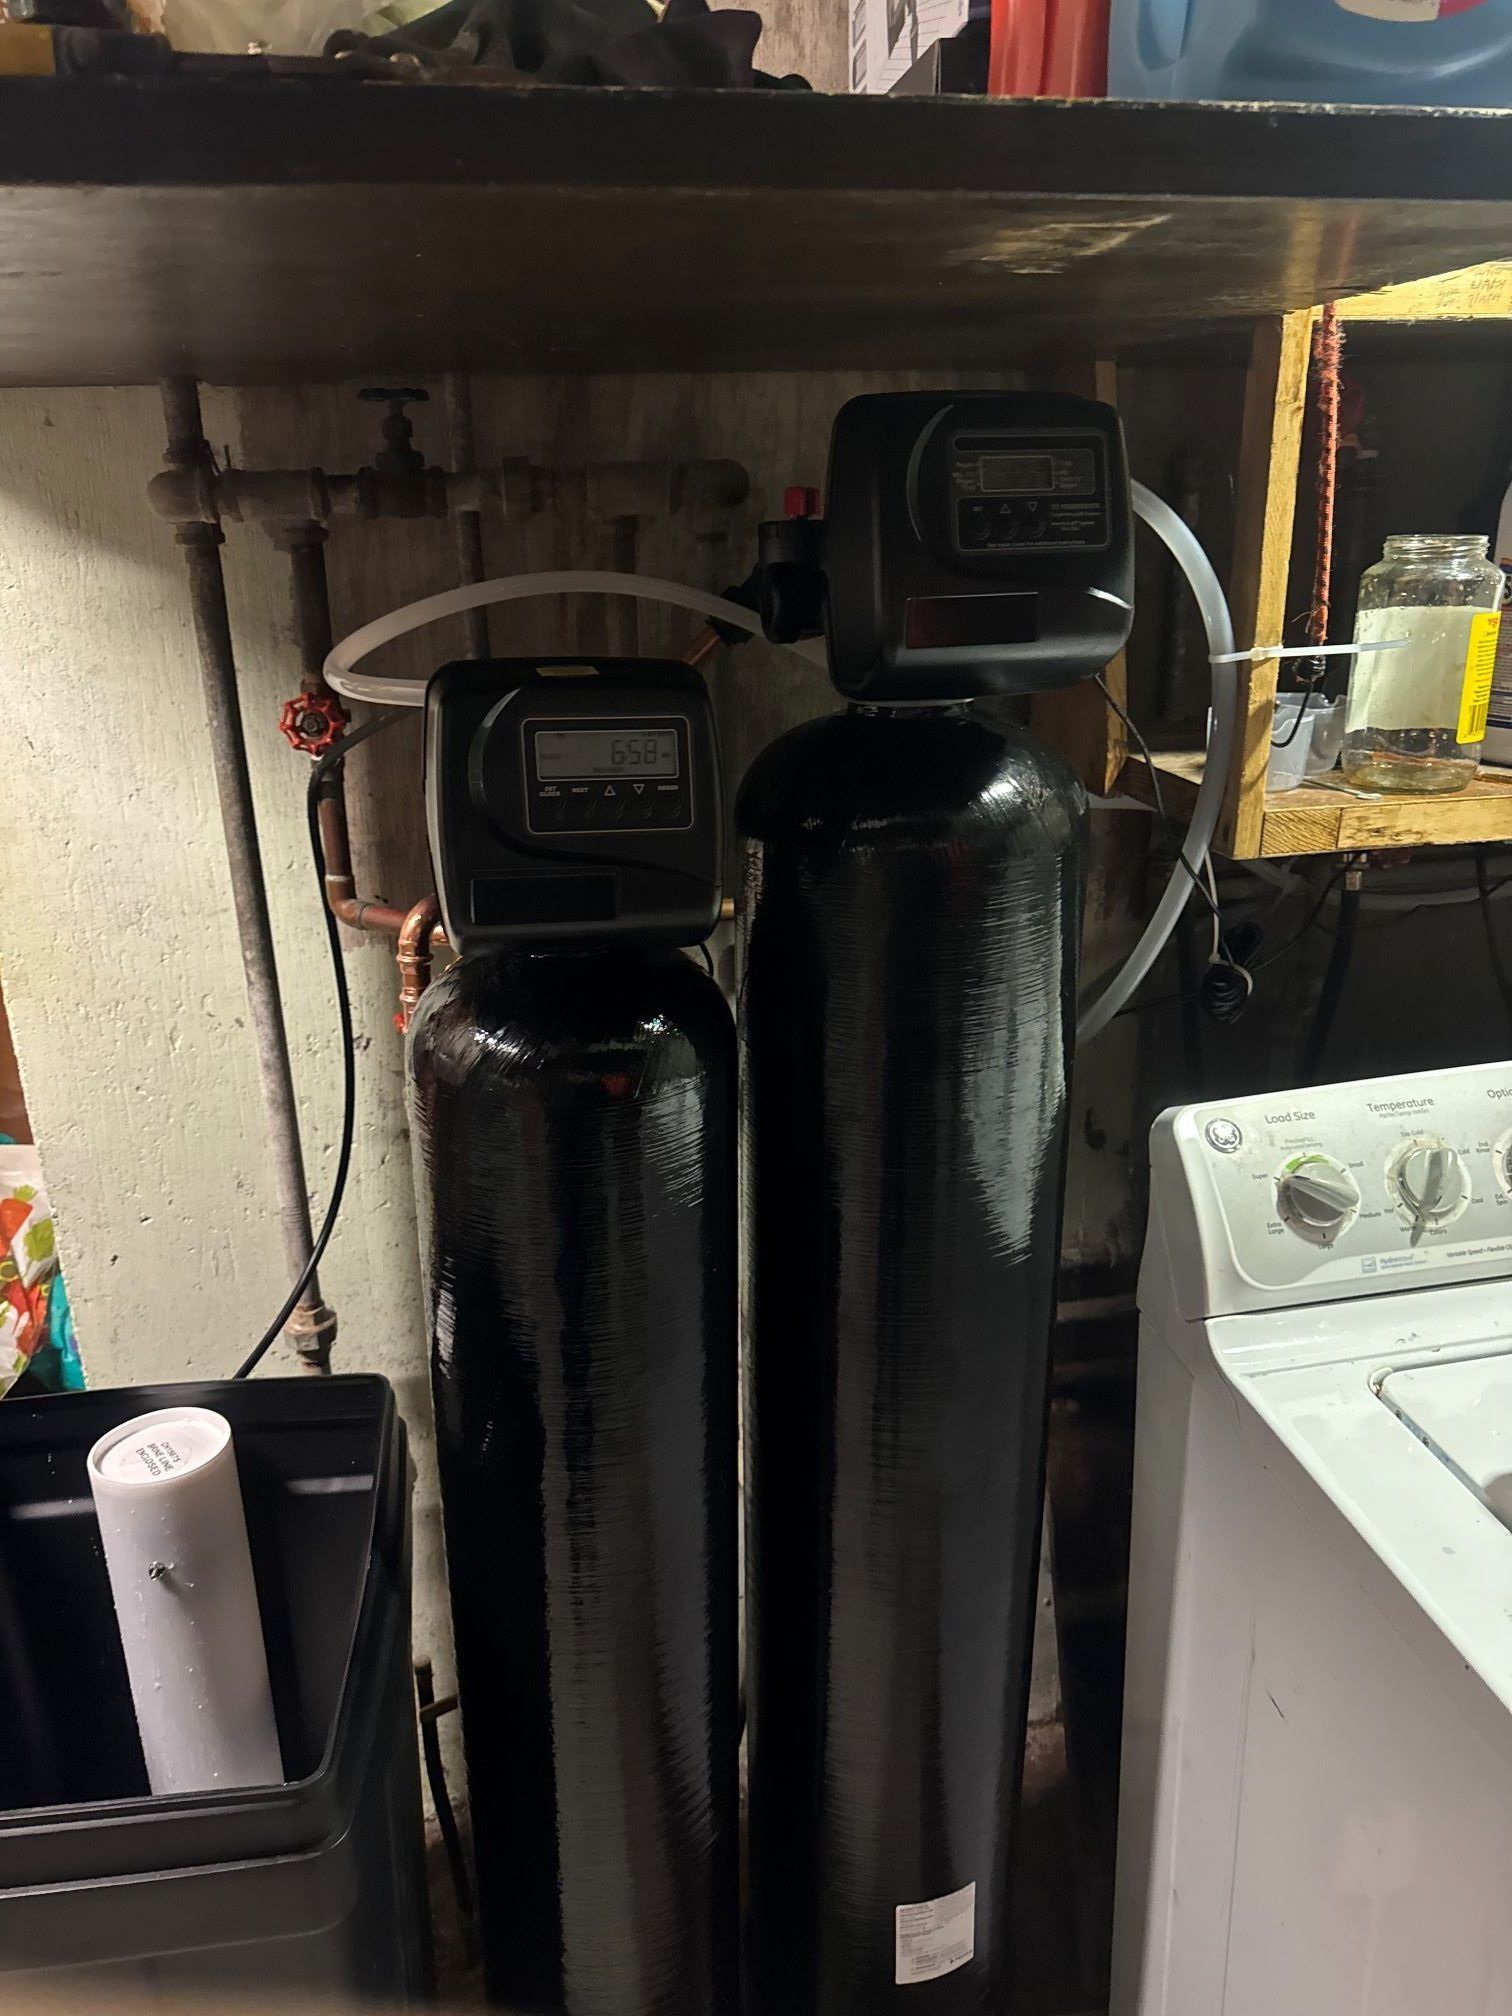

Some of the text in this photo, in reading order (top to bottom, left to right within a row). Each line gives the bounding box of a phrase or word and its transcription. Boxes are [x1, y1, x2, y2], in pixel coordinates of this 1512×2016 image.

[611, 739, 657, 765] 6:58
[1366, 1097, 1435, 1113] Temperature
[1264, 1110, 1316, 1125] Load Size
[1412, 1128, 1424, 1137] Cold
[1348, 1160, 1364, 1169] Small
[1251, 1172, 1269, 1183] Super
[1359, 1210, 1382, 1219] Medium
[1266, 1221, 1282, 1229] Extra
[1267, 1227, 1285, 1237] Large
[1429, 1228, 1448, 1236] Colors
[135, 1447, 162, 1477] ENCLOSED
[158, 1455, 175, 1473] LINE
